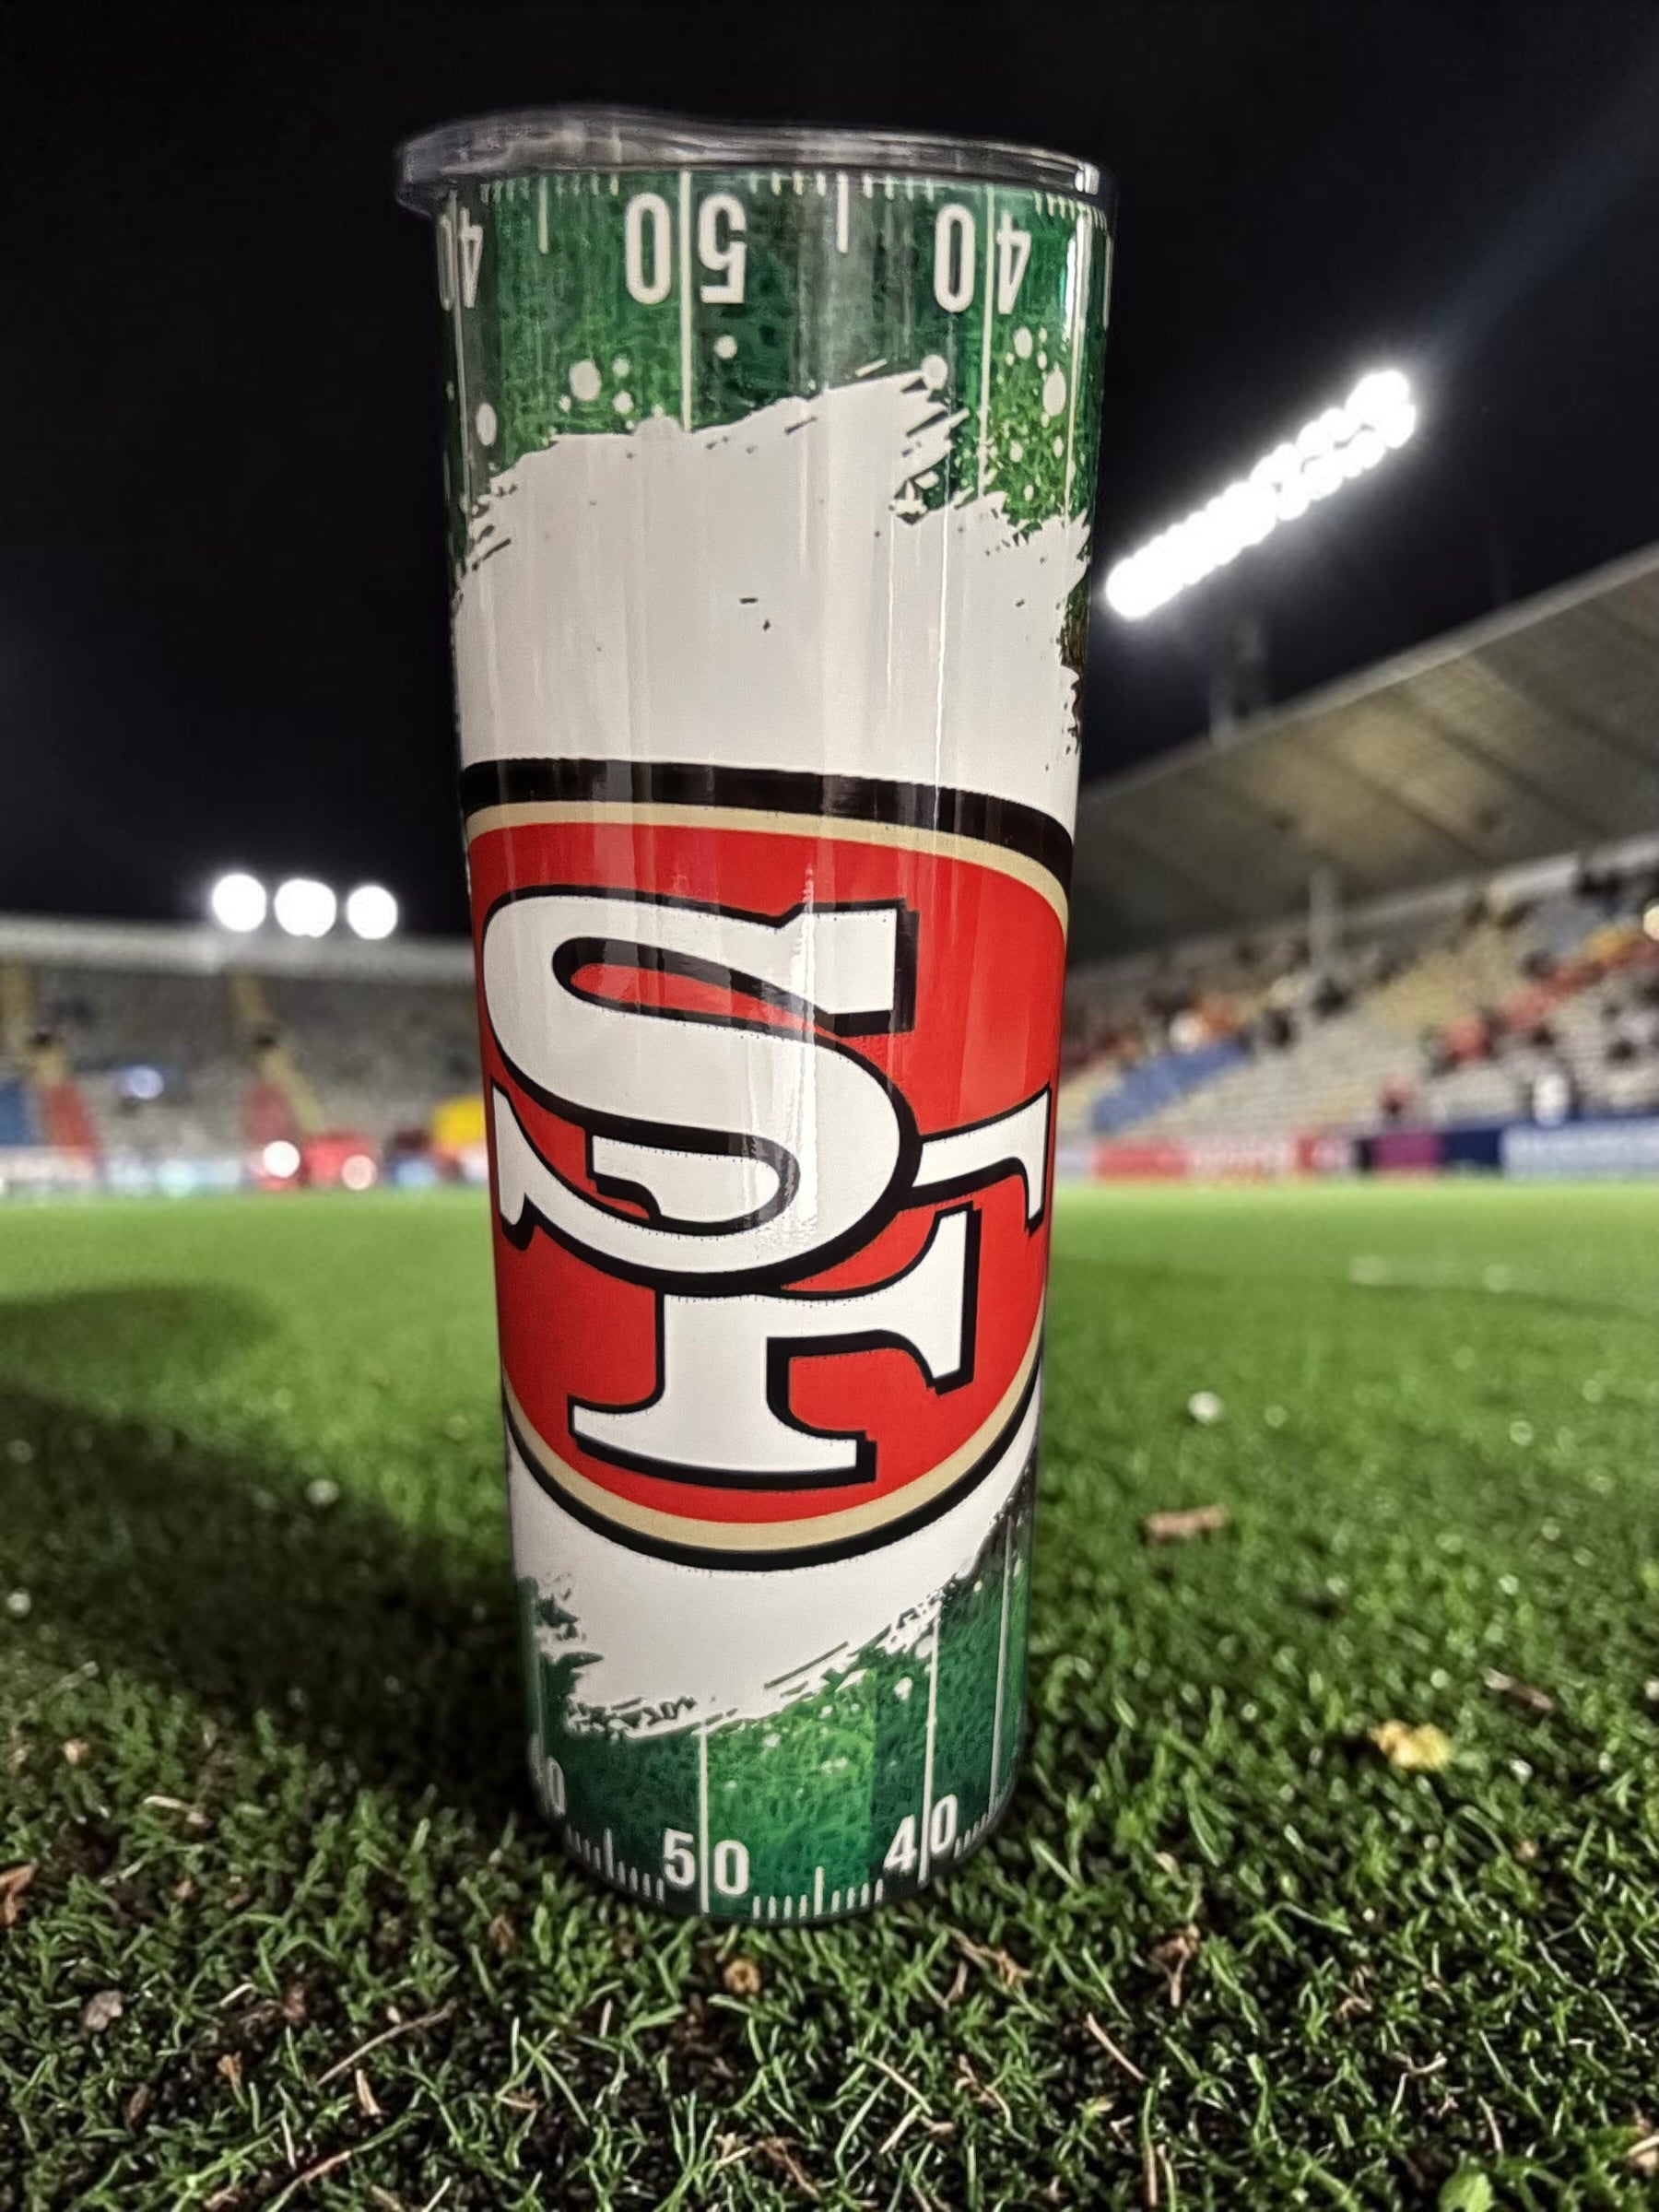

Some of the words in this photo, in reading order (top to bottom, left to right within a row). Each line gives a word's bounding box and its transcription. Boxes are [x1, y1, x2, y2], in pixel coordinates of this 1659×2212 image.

[625, 193, 745, 304] 50
[933, 203, 1031, 314] 40
[481, 886, 1052, 1489] SF
[664, 1828, 749, 1895] 50
[883, 1794, 958, 1872] 40
